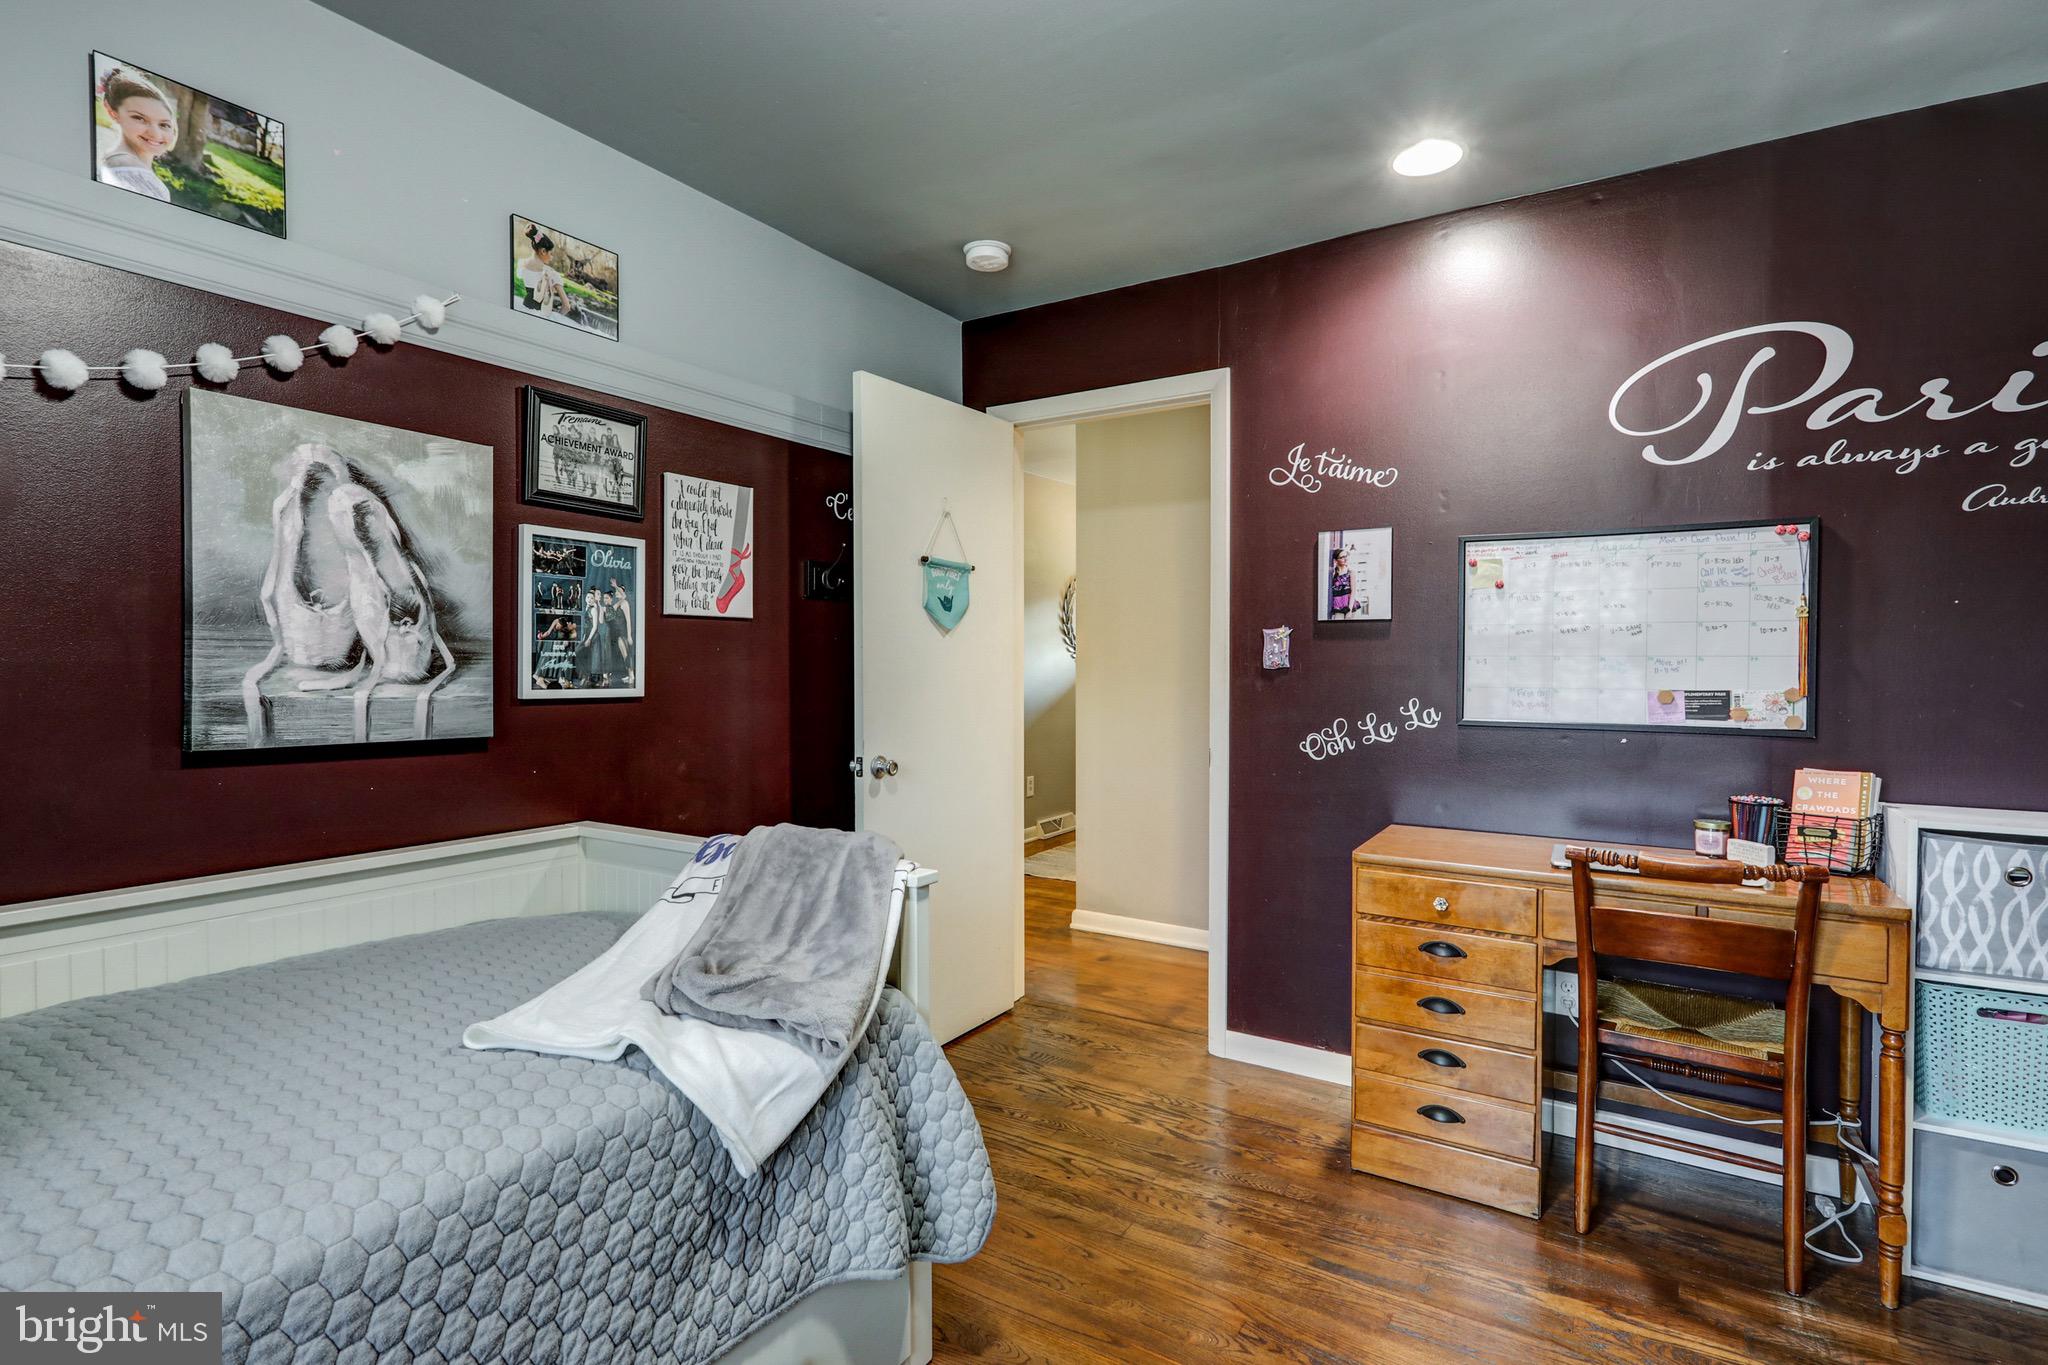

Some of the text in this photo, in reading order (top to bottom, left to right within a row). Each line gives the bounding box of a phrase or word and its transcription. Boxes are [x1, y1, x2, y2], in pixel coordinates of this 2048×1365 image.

[552, 411, 607, 426] Tremaine
[541, 433, 634, 461] ACHIEVEMENT AWARD
[1747, 452, 1784, 471] is
[1796, 439, 1949, 474] always
[1964, 441, 1999, 455] a
[1269, 442, 1322, 494] Je
[591, 549, 632, 570] Olivia
[1299, 698, 1441, 761] Ooh La La
[1808, 777, 1847, 786] WHERE
[1816, 791, 1839, 799] THE
[1795, 803, 1857, 815] CRAWDADS
